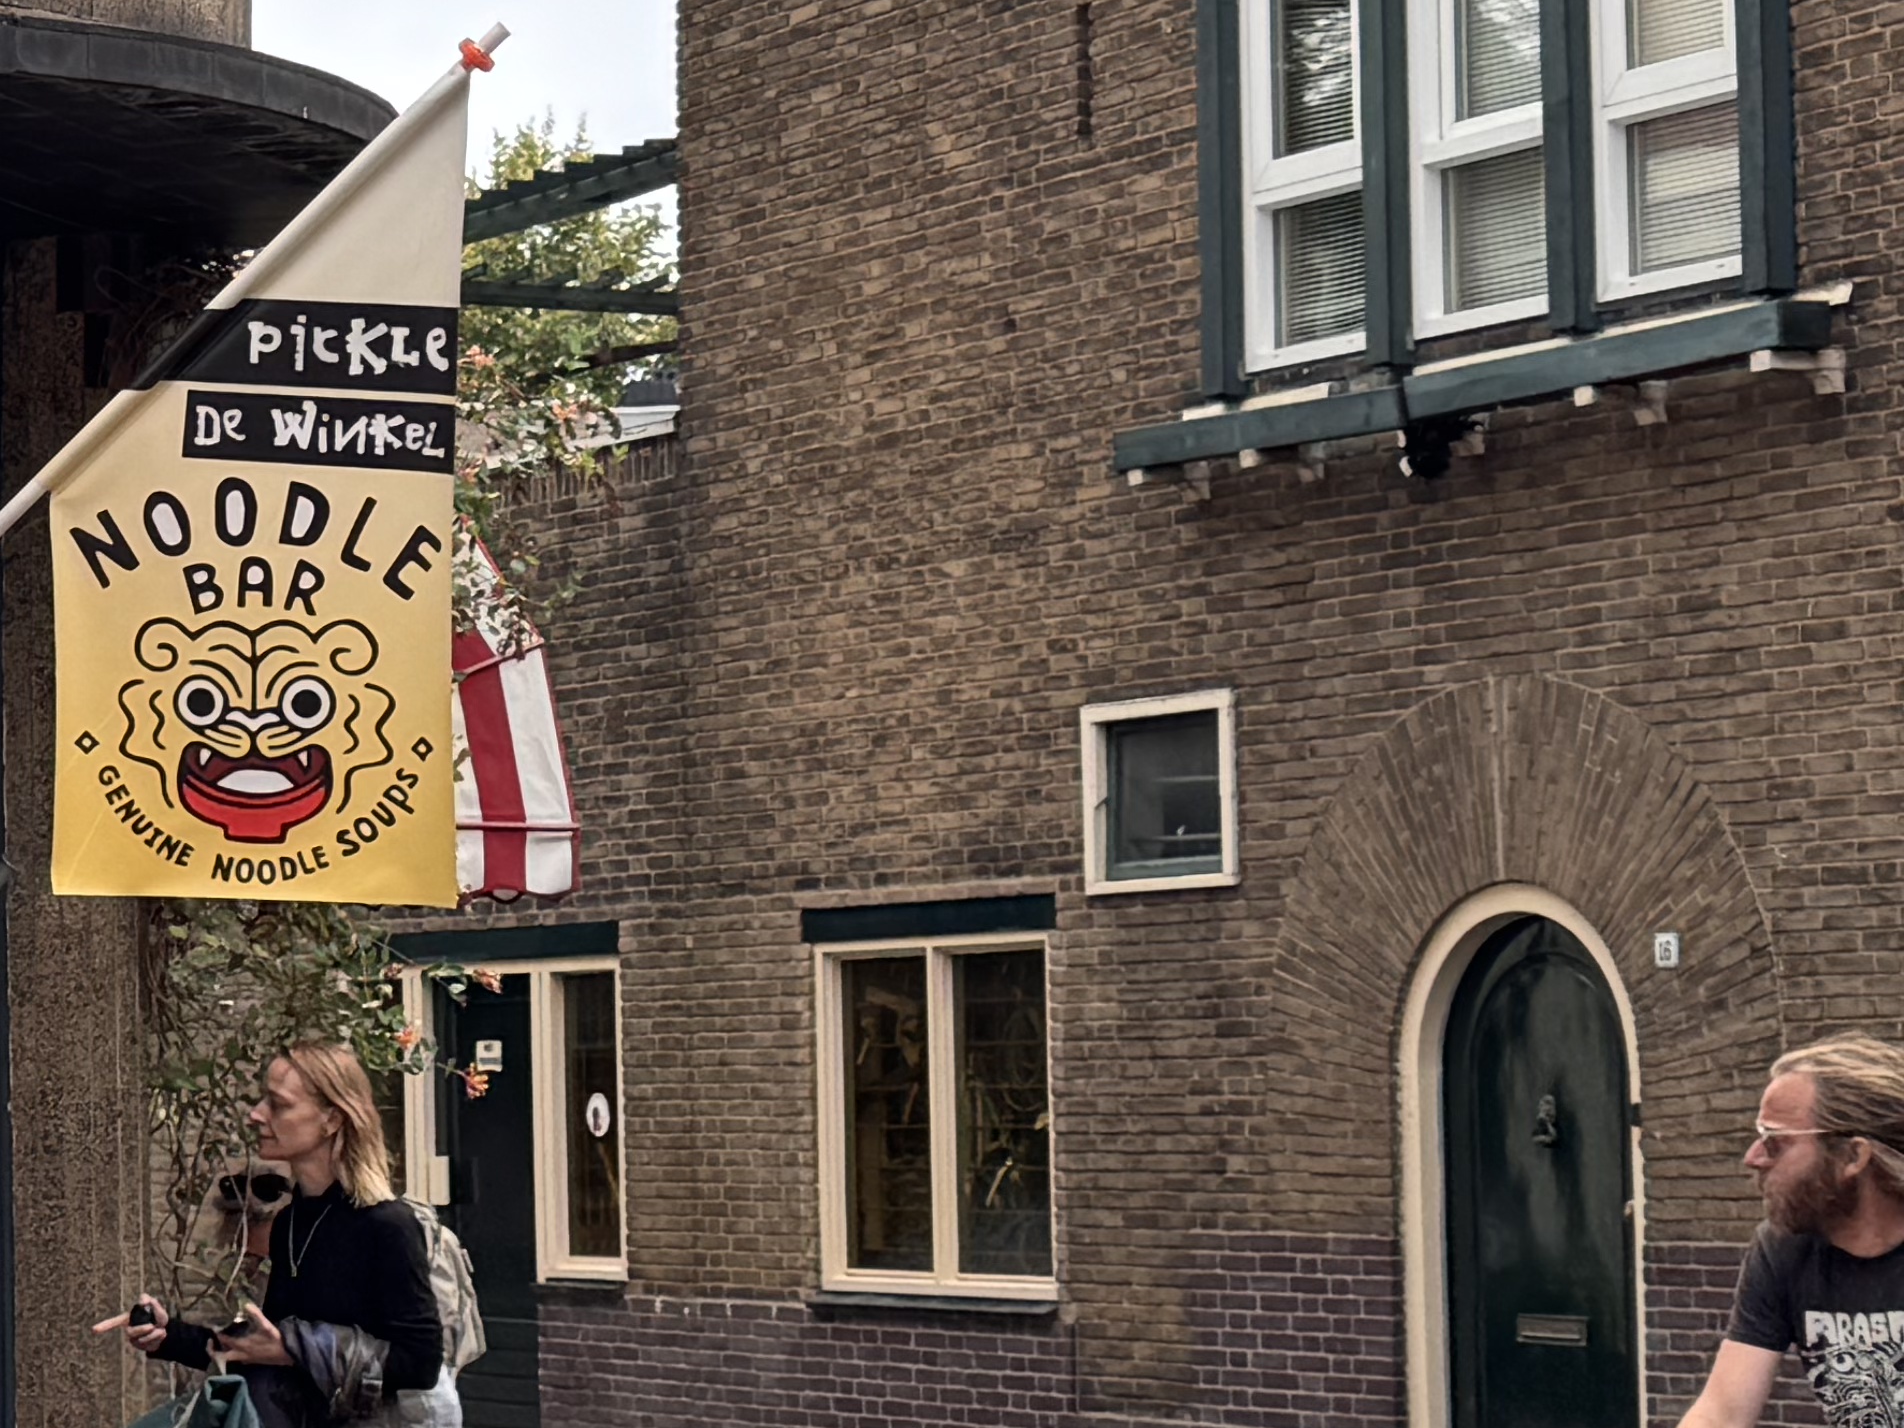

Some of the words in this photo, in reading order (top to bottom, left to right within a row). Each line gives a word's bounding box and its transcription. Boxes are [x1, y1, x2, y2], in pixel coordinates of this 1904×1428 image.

[68, 476, 443, 602] NOODLE
[182, 555, 325, 617] BAR
[98, 764, 196, 868] GENUINE
[210, 845, 331, 886] NOODLE
[335, 767, 420, 858] SOUPS
